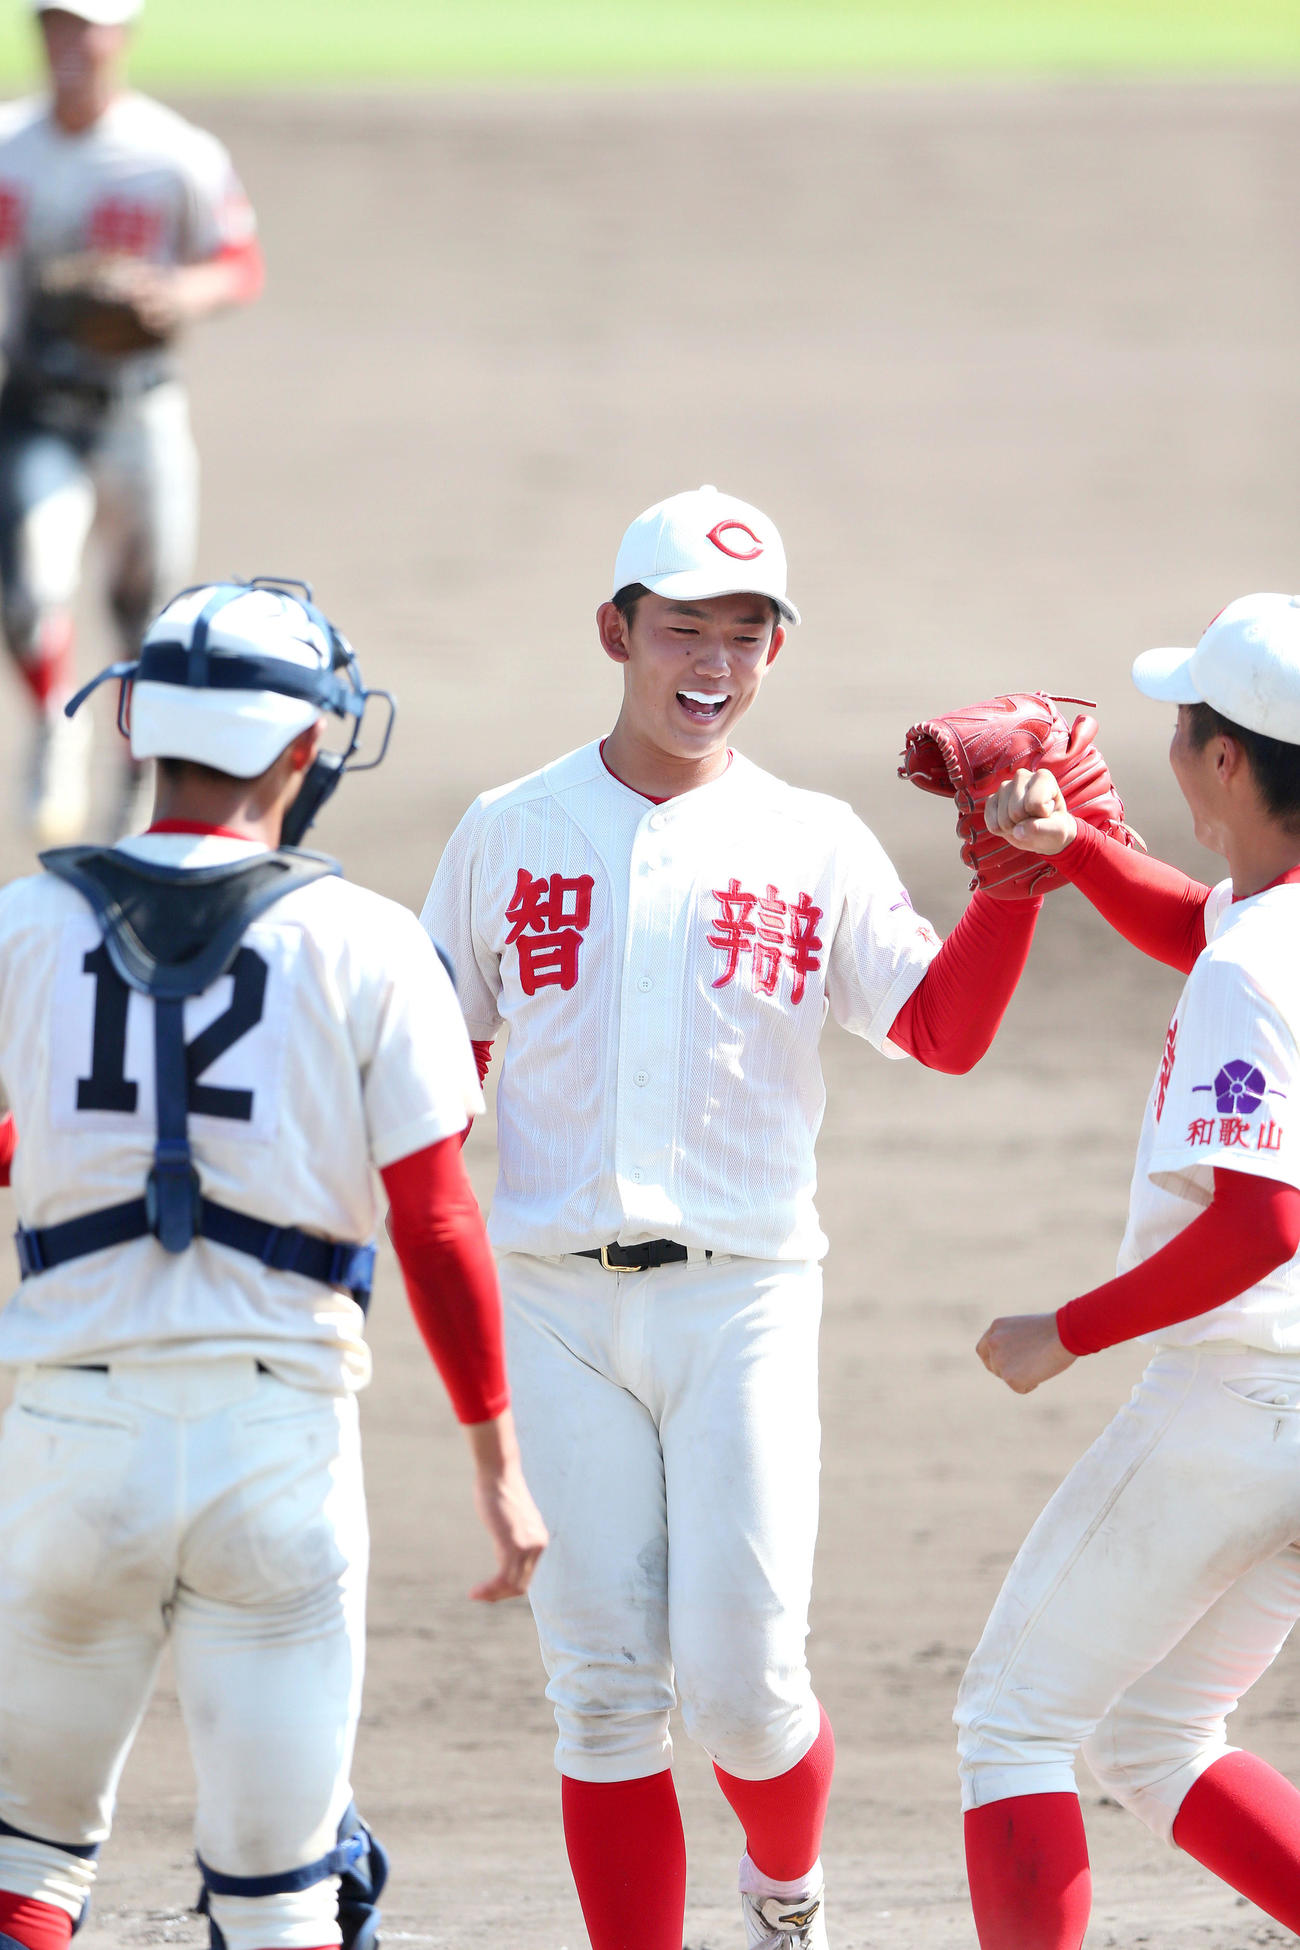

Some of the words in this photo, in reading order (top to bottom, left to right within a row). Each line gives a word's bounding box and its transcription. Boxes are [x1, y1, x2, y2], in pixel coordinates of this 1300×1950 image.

[706, 519, 764, 560] C
[504, 867, 594, 996] 智
[76, 938, 269, 1122] 12
[1186, 1117, 1283, 1151] 和歌山
